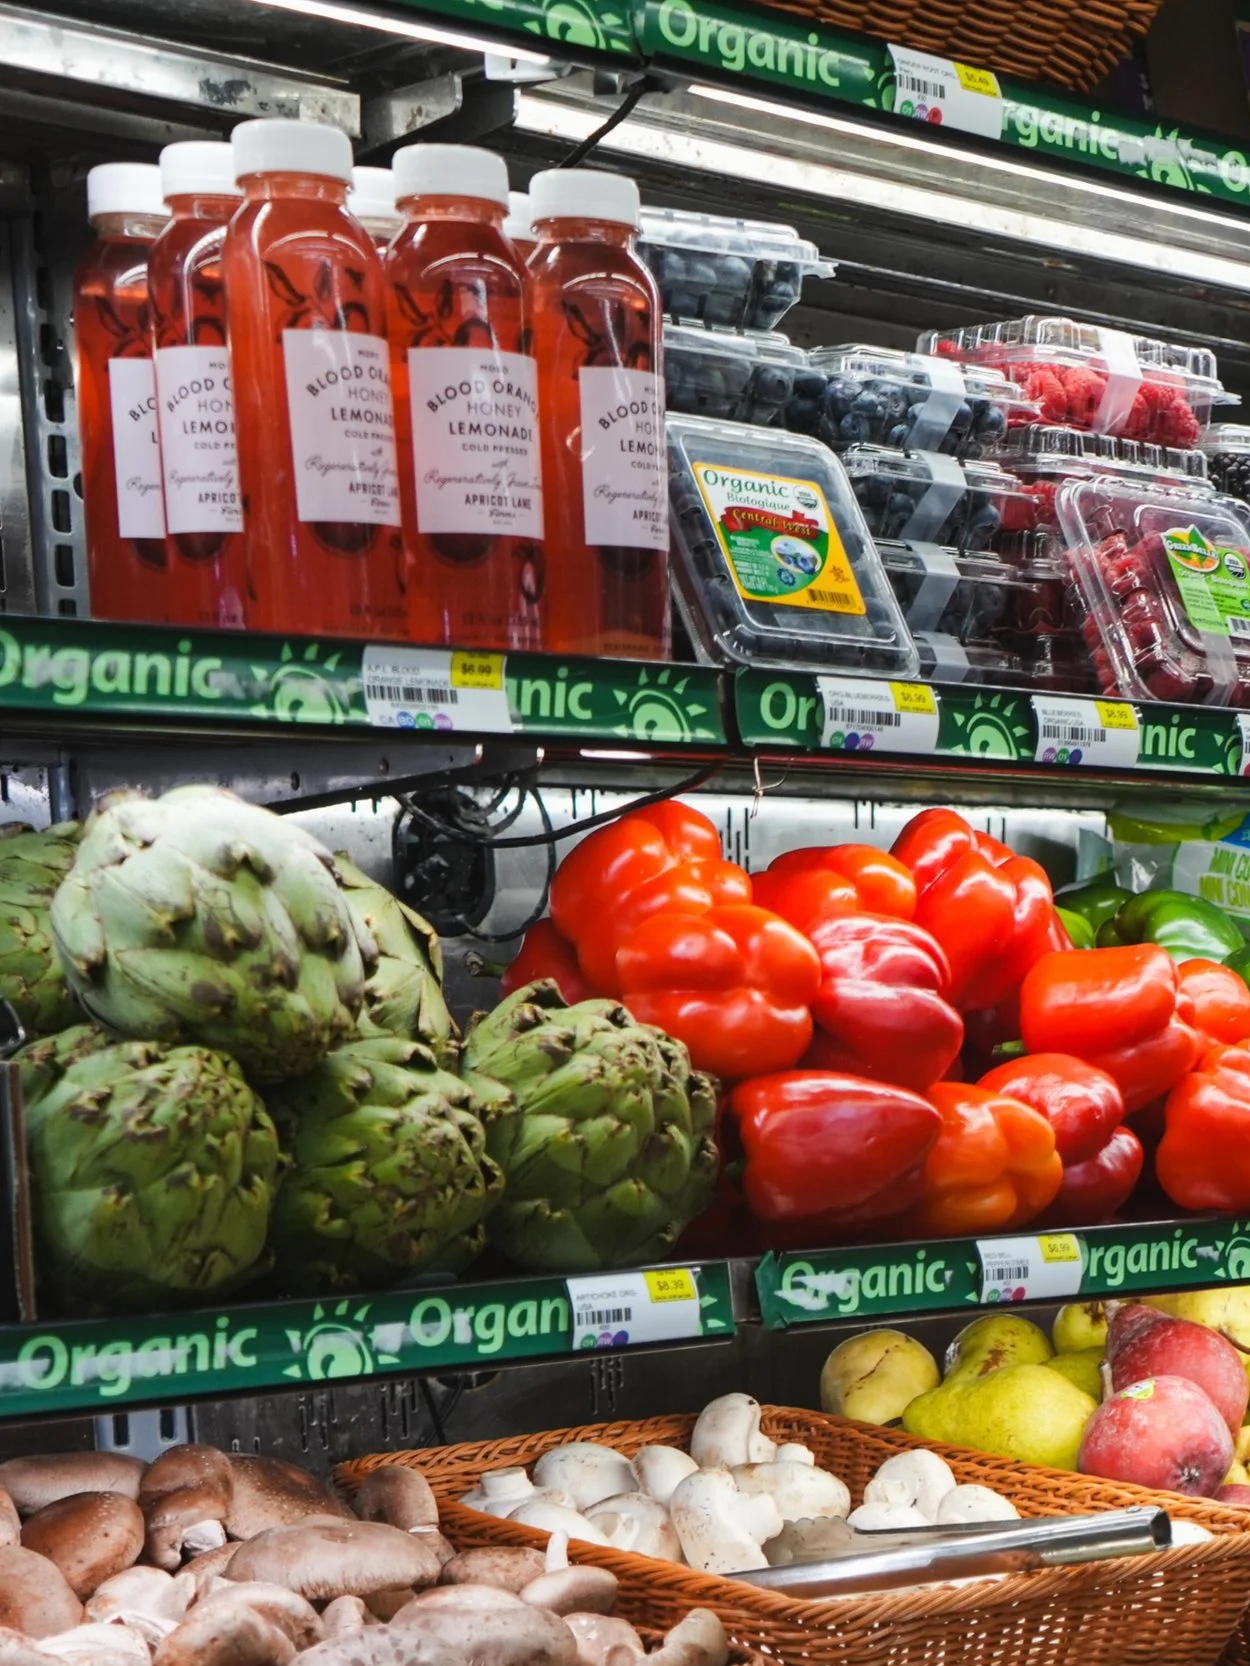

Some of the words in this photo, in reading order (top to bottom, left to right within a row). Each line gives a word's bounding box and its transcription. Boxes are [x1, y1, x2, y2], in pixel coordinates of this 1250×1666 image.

[658, 0, 841, 88] Organic
[1002, 97, 1119, 160] rganic
[305, 365, 364, 397] BLOOD
[369, 367, 390, 385] ORA
[198, 401, 231, 413] HON
[427, 380, 486, 413] BLOOD
[129, 397, 156, 422] BLO
[331, 407, 393, 429] LEMONA
[467, 401, 522, 419] HONEY
[598, 401, 649, 431] BLOOD
[183, 420, 235, 435] LEMO
[449, 421, 533, 442] LEMONADE
[461, 442, 491, 452] COLD
[493, 444, 528, 456] PRESSED
[348, 482, 385, 496] APRICOT
[424, 469, 502, 491] Regeneratively
[703, 469, 790, 499] Organic
[464, 493, 509, 508] APRICOT
[512, 495, 532, 511] LANE
[727, 492, 791, 512] Biologique
[732, 509, 779, 527] Central
[782, 521, 813, 537] West
[0, 628, 222, 706] Organic
[460, 662, 493, 678] $6.99
[1047, 1242, 1071, 1254] $6.99
[656, 1280, 685, 1292] $8.39
[408, 1296, 568, 1354] Organ
[17, 1316, 258, 1397] Organic
